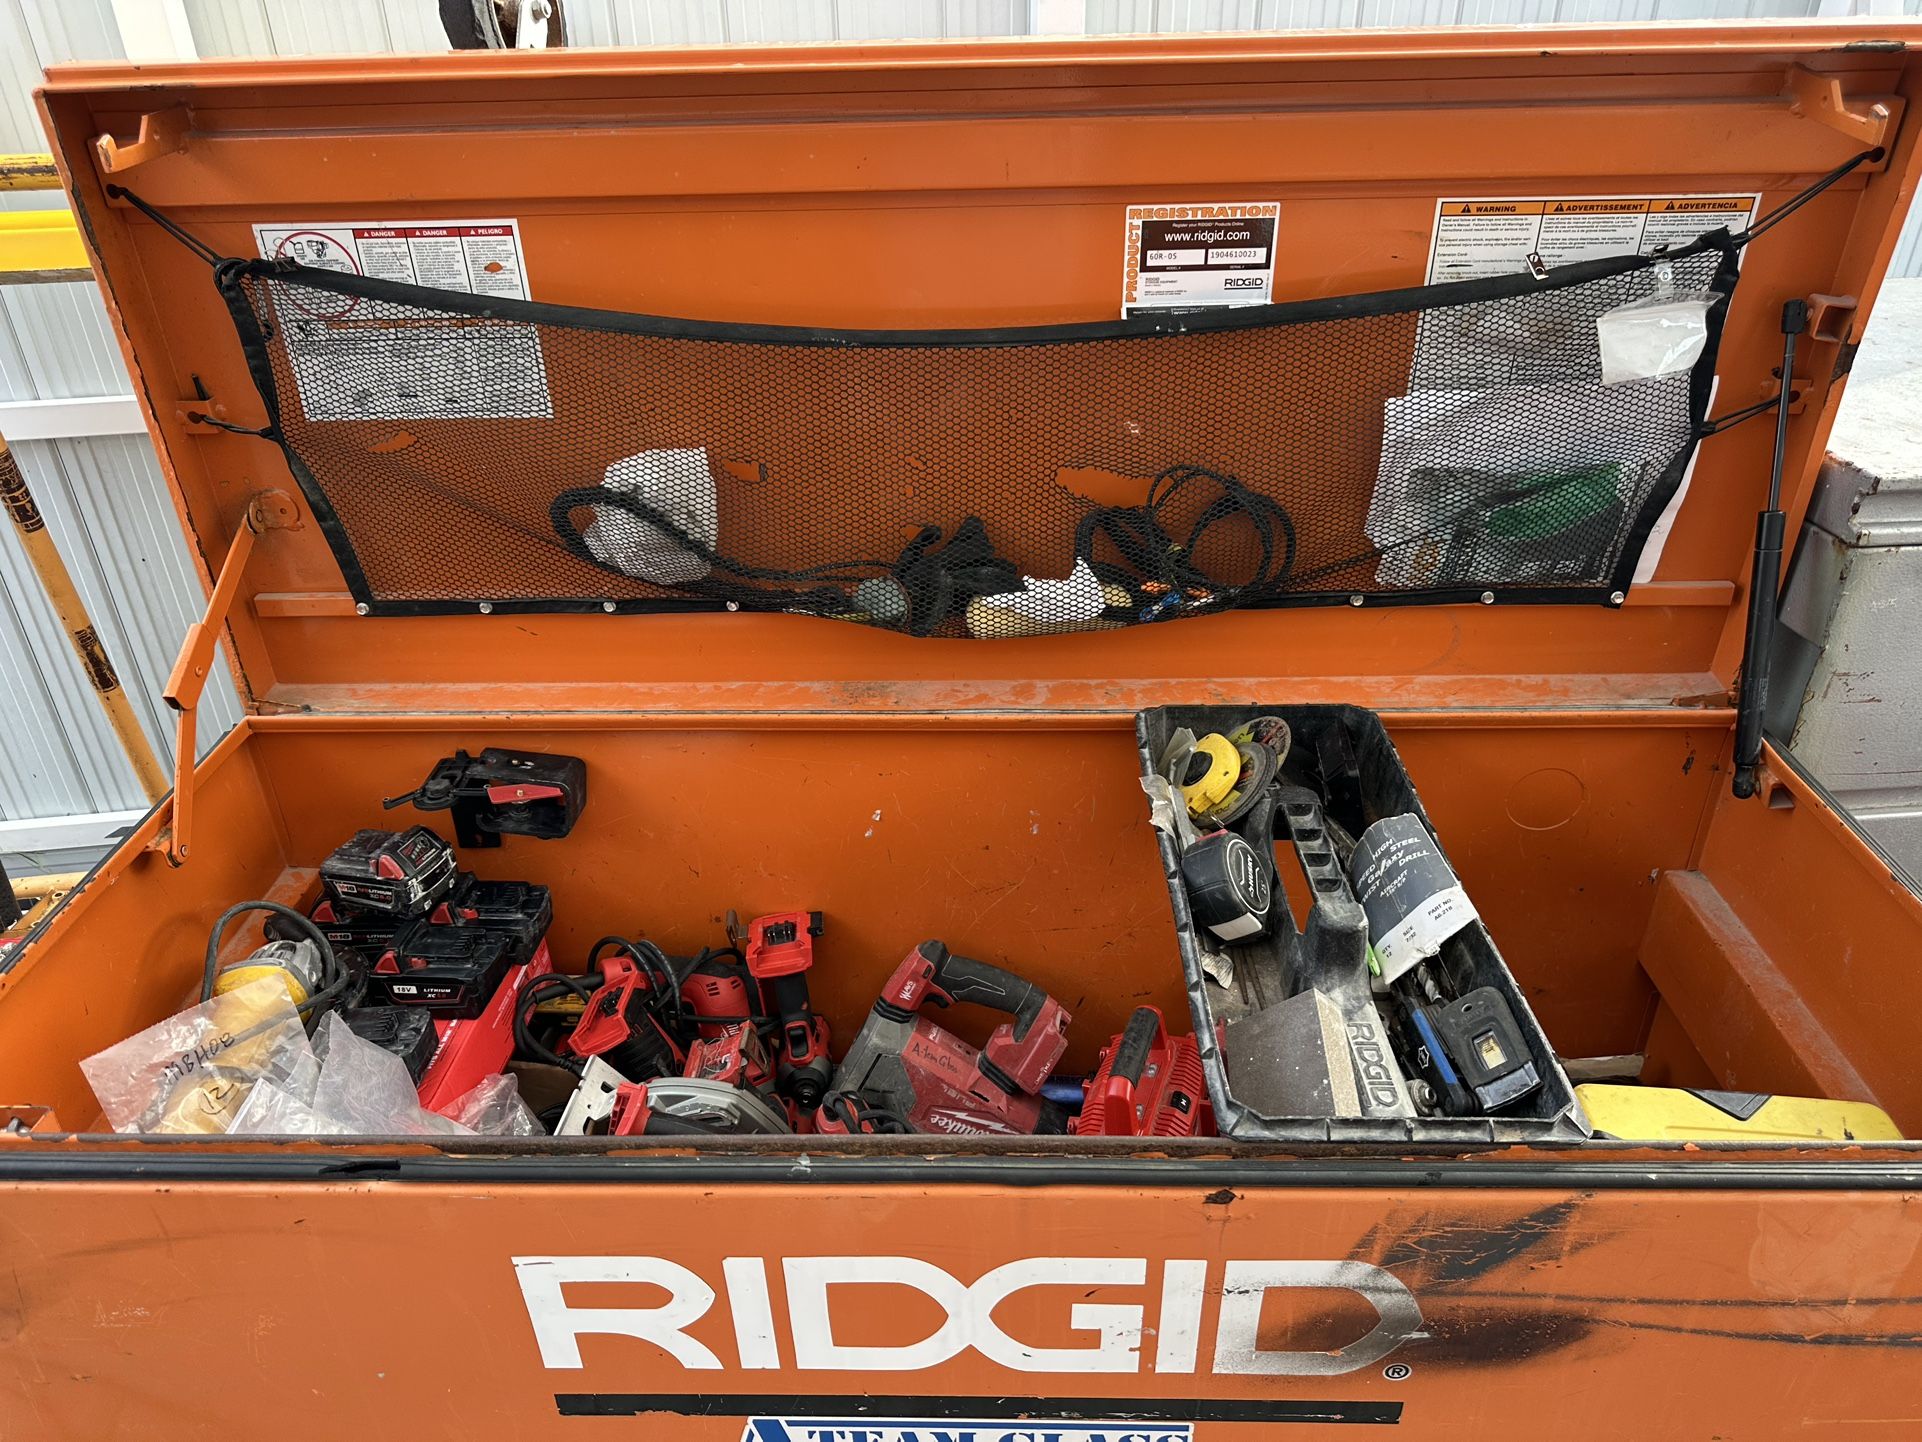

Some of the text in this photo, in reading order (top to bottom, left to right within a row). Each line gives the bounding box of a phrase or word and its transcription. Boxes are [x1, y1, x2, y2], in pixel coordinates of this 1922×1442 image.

[1129, 205, 1277, 220] REGISTRATION
[1476, 205, 1517, 213] WARNING
[1565, 203, 1645, 212] ADVERTISSEMENT
[1677, 202, 1738, 210] ADVERTENCIA
[1164, 229, 1251, 244] www.ridgid.com
[1210, 250, 1257, 259] 1904610023
[1125, 222, 1141, 303] PRODUCT
[1224, 277, 1263, 288] RIDGID
[1373, 838, 1394, 859] HIGH
[1390, 837, 1421, 853] STEEL
[1398, 849, 1431, 867] DRILL
[1380, 869, 1408, 897] AIRCRAFT
[1427, 903, 1442, 916] PART
[1347, 1022, 1400, 1108] RIDGID
